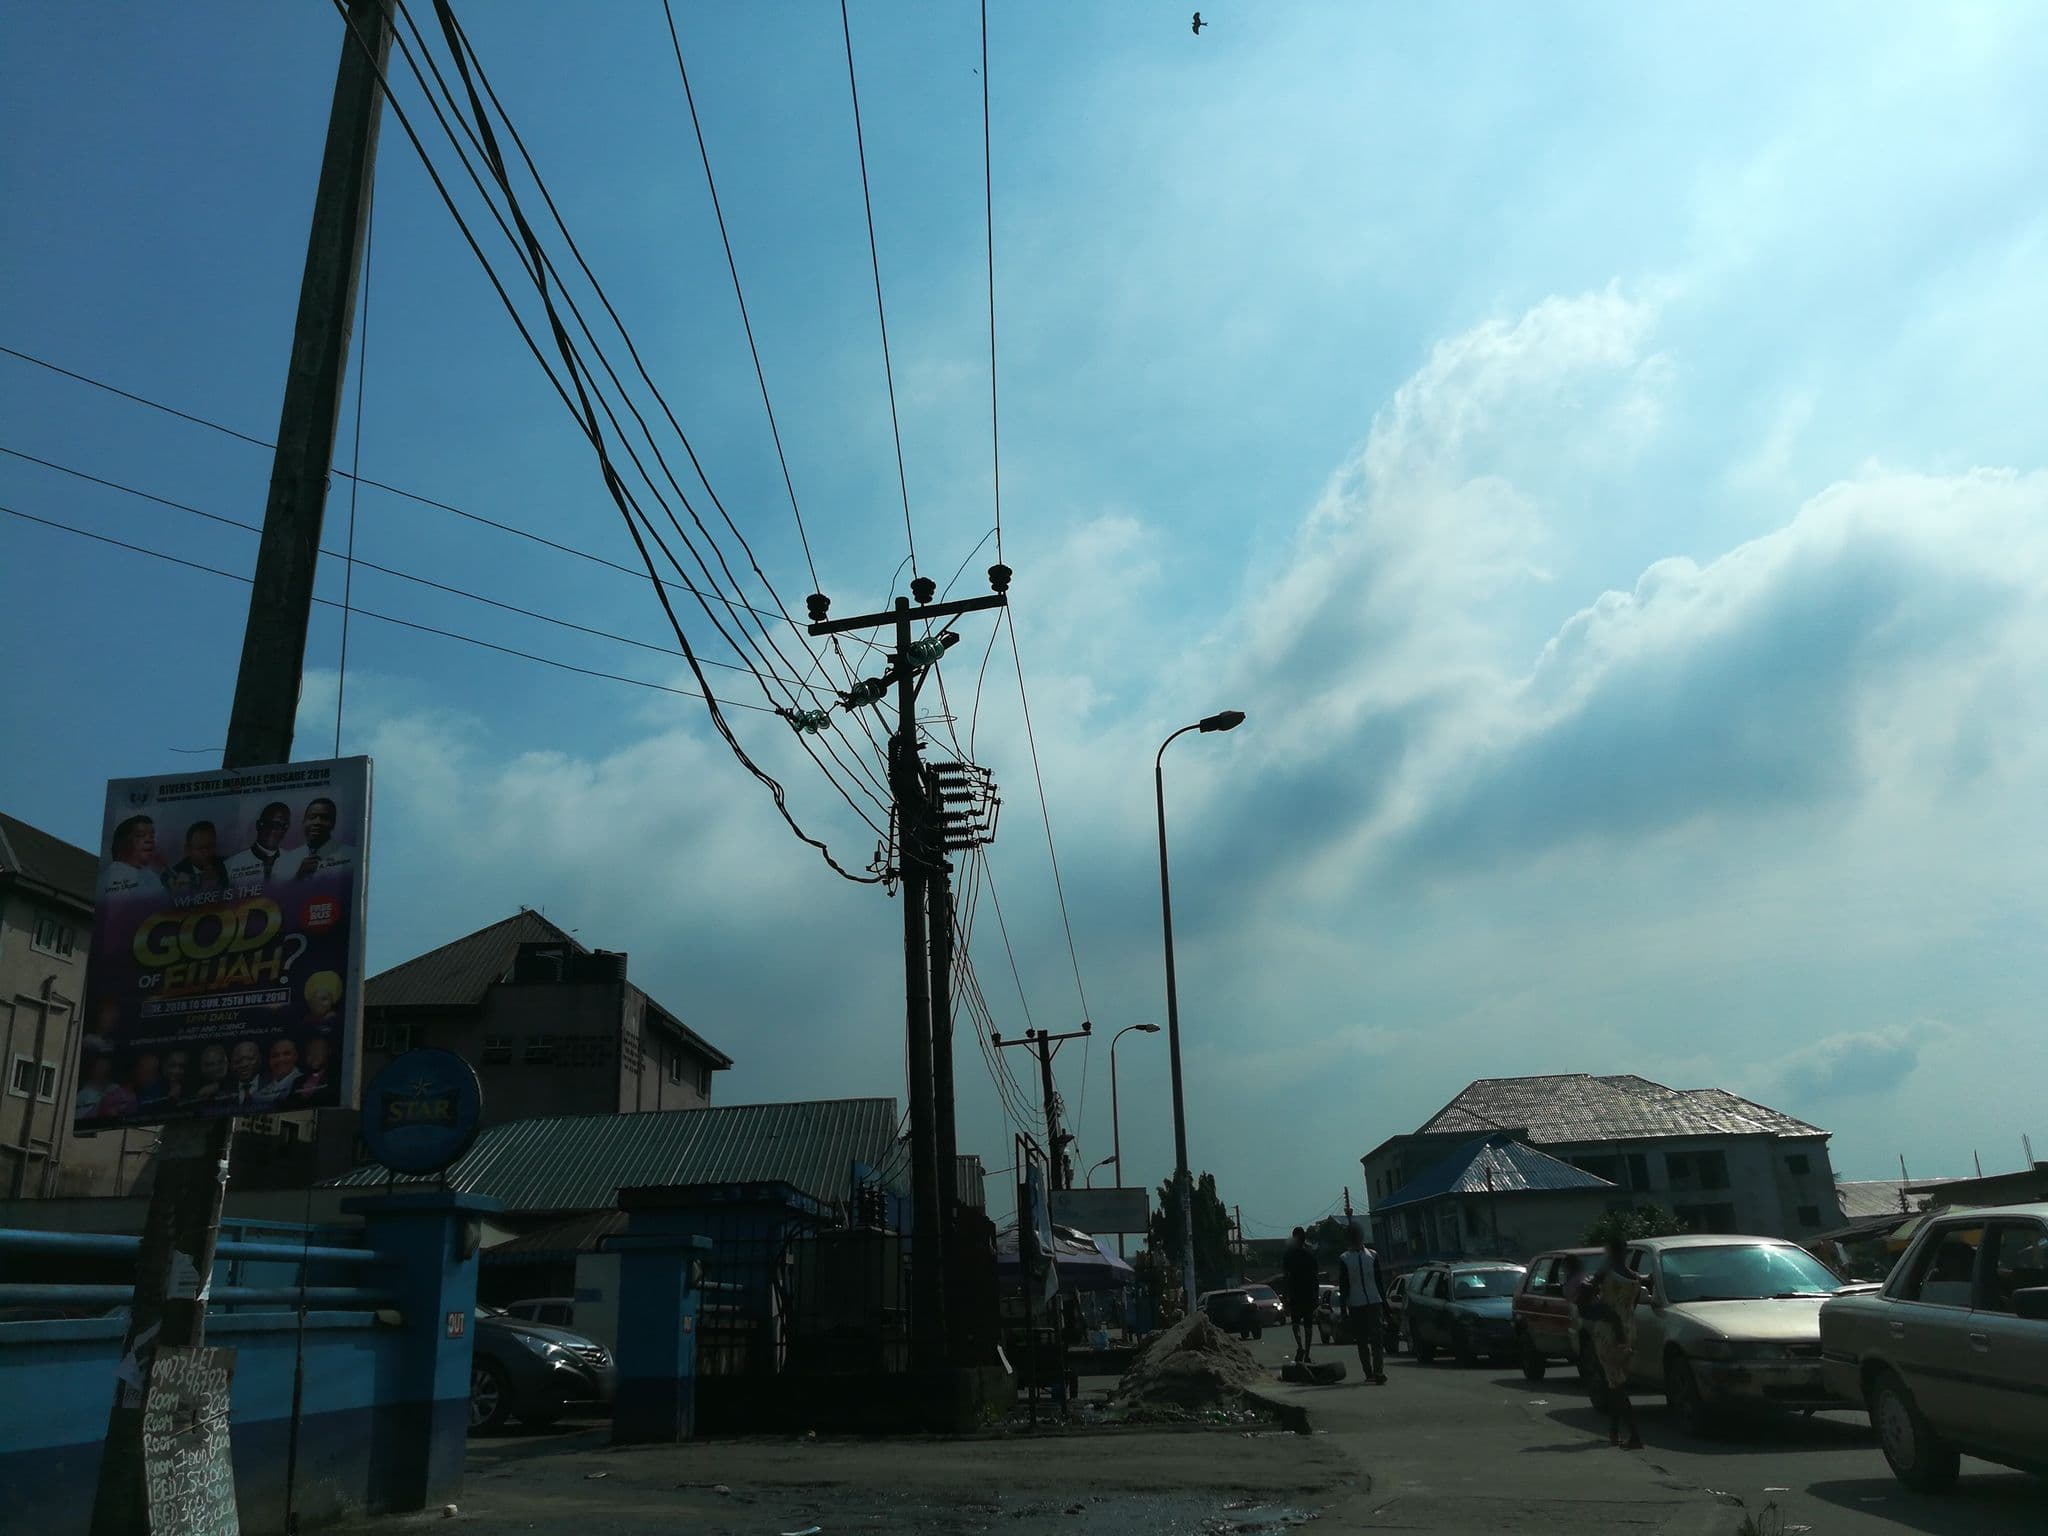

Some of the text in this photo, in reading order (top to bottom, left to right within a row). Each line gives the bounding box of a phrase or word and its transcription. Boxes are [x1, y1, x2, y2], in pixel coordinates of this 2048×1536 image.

[159, 783, 192, 796] RIVERS
[194, 779, 221, 792] STATE
[307, 767, 331, 780] 2018
[174, 883, 264, 908] WHERE IS THE
[133, 897, 282, 968] GOD
[138, 973, 161, 989] OF
[389, 1099, 452, 1121] STAR
[190, 1346, 219, 1370] LET
[145, 1386, 179, 1413] ROOM
[143, 1412, 174, 1434] ROOM
